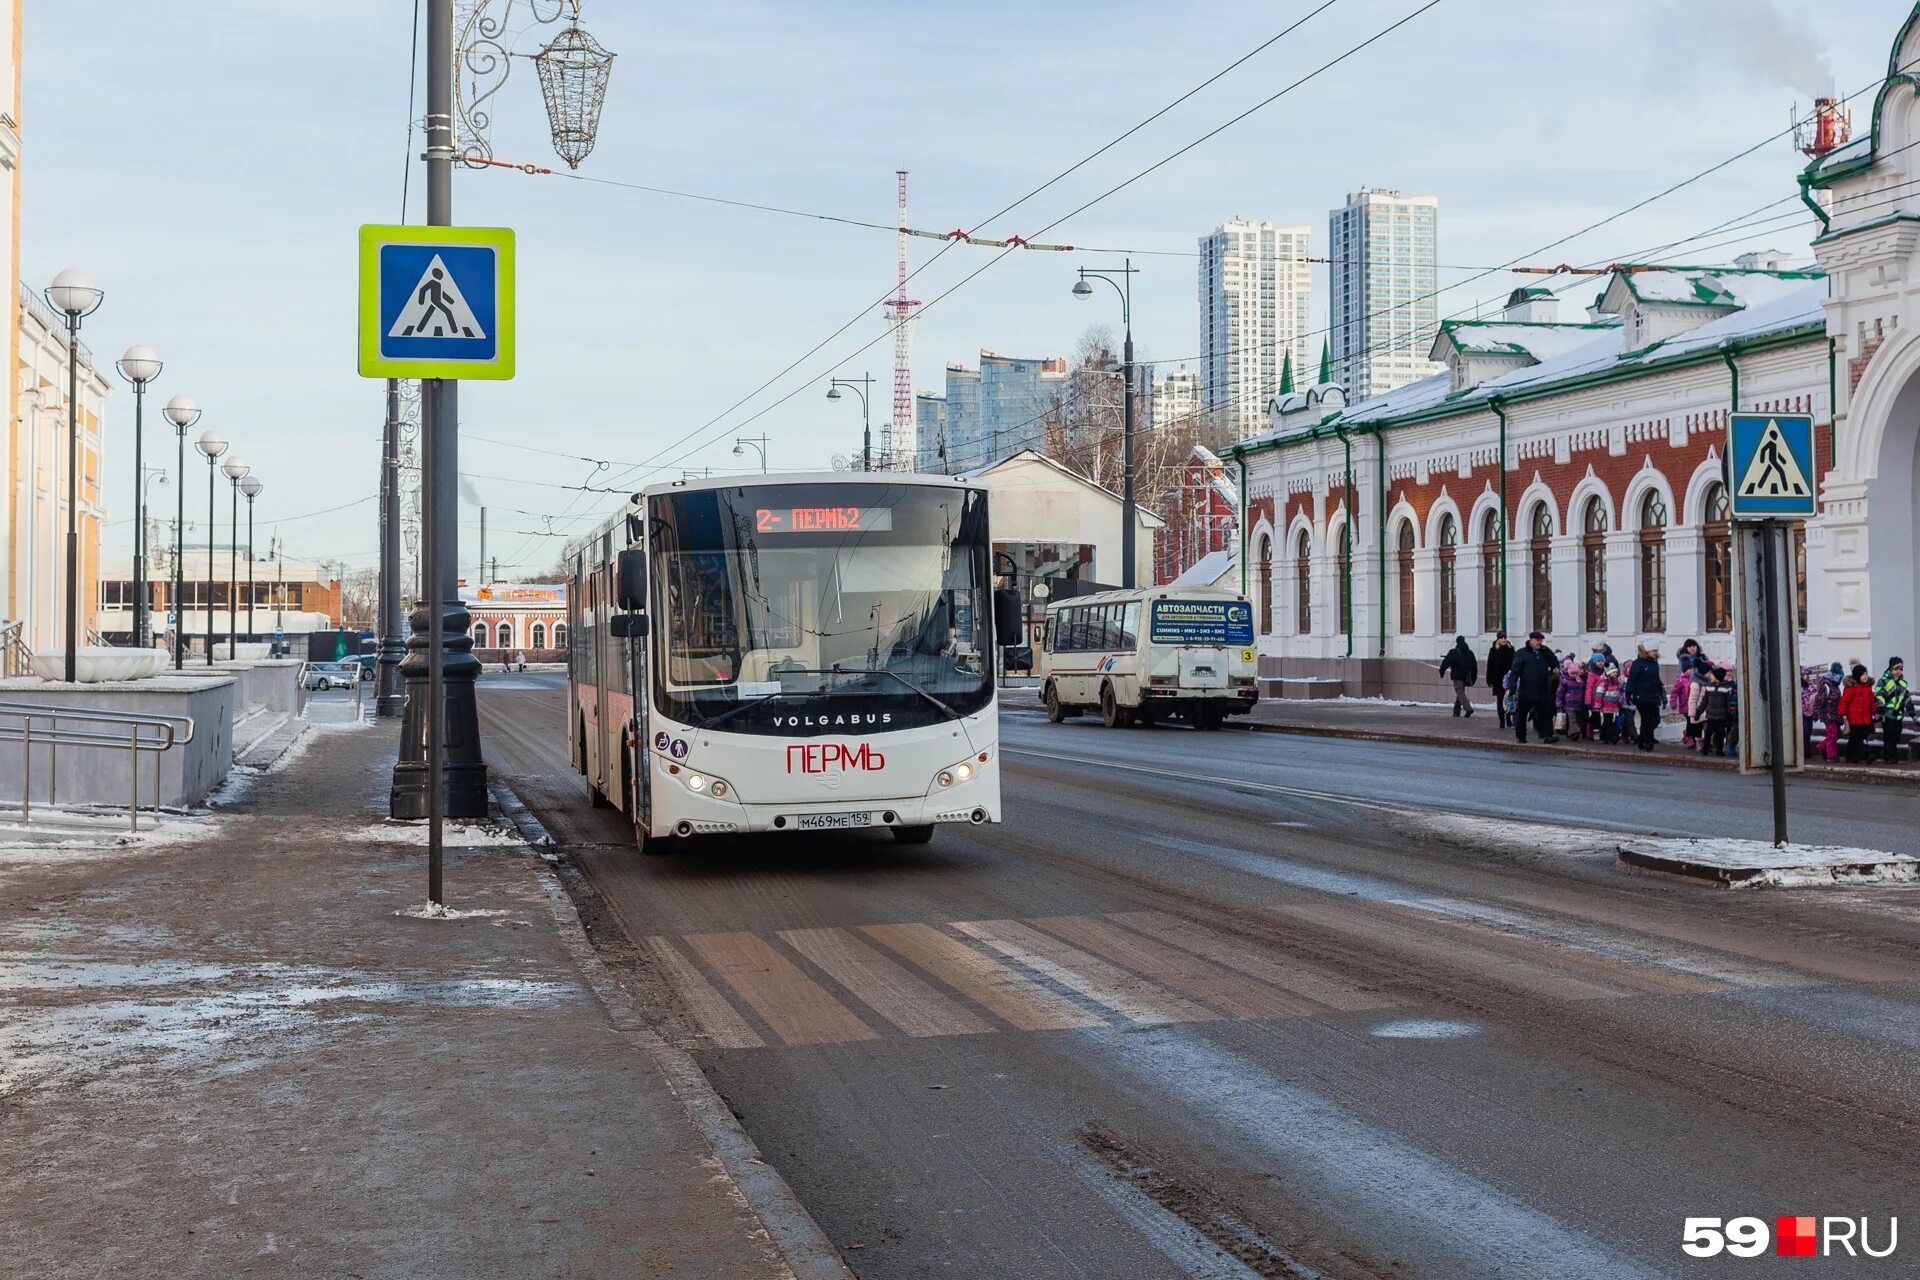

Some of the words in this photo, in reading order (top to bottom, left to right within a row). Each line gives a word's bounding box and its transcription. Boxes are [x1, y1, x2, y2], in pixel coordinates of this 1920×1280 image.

[791, 507, 859, 530] ПЕРМЬ2
[1156, 604, 1225, 613] АВТОЗАПЧАСТИ
[169, 614, 176, 623] P
[1245, 652, 1252, 660] 3
[773, 713, 892, 726] VOLGABUS
[787, 743, 885, 773] ПЕРМЬ
[801, 815, 848, 828] М469МЕ
[851, 813, 868, 823] 159
